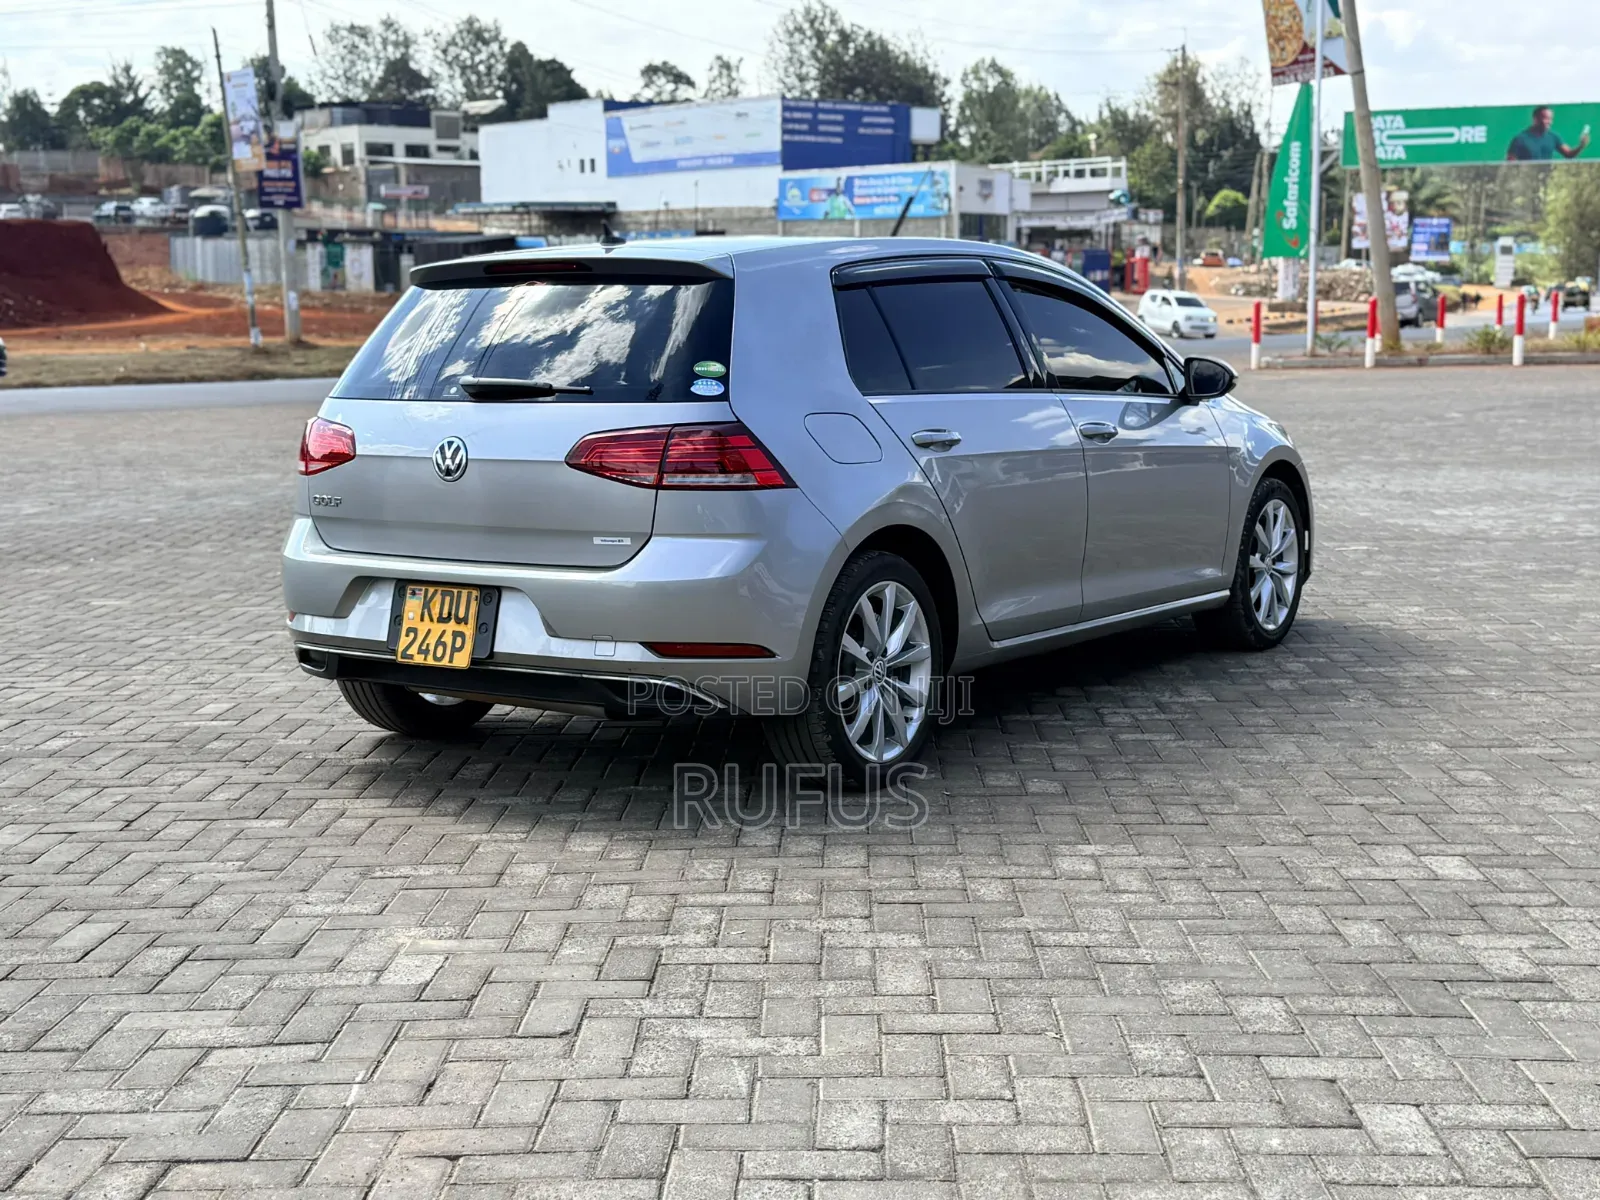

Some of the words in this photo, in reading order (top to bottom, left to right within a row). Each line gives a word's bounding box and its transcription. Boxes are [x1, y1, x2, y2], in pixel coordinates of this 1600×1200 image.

[1371, 114, 1406, 130] ATA
[1375, 144, 1408, 161] ATA
[1282, 141, 1302, 229] Safaricom
[312, 494, 343, 508] GOLF
[420, 587, 473, 626] KDU
[400, 626, 467, 664] 246P
